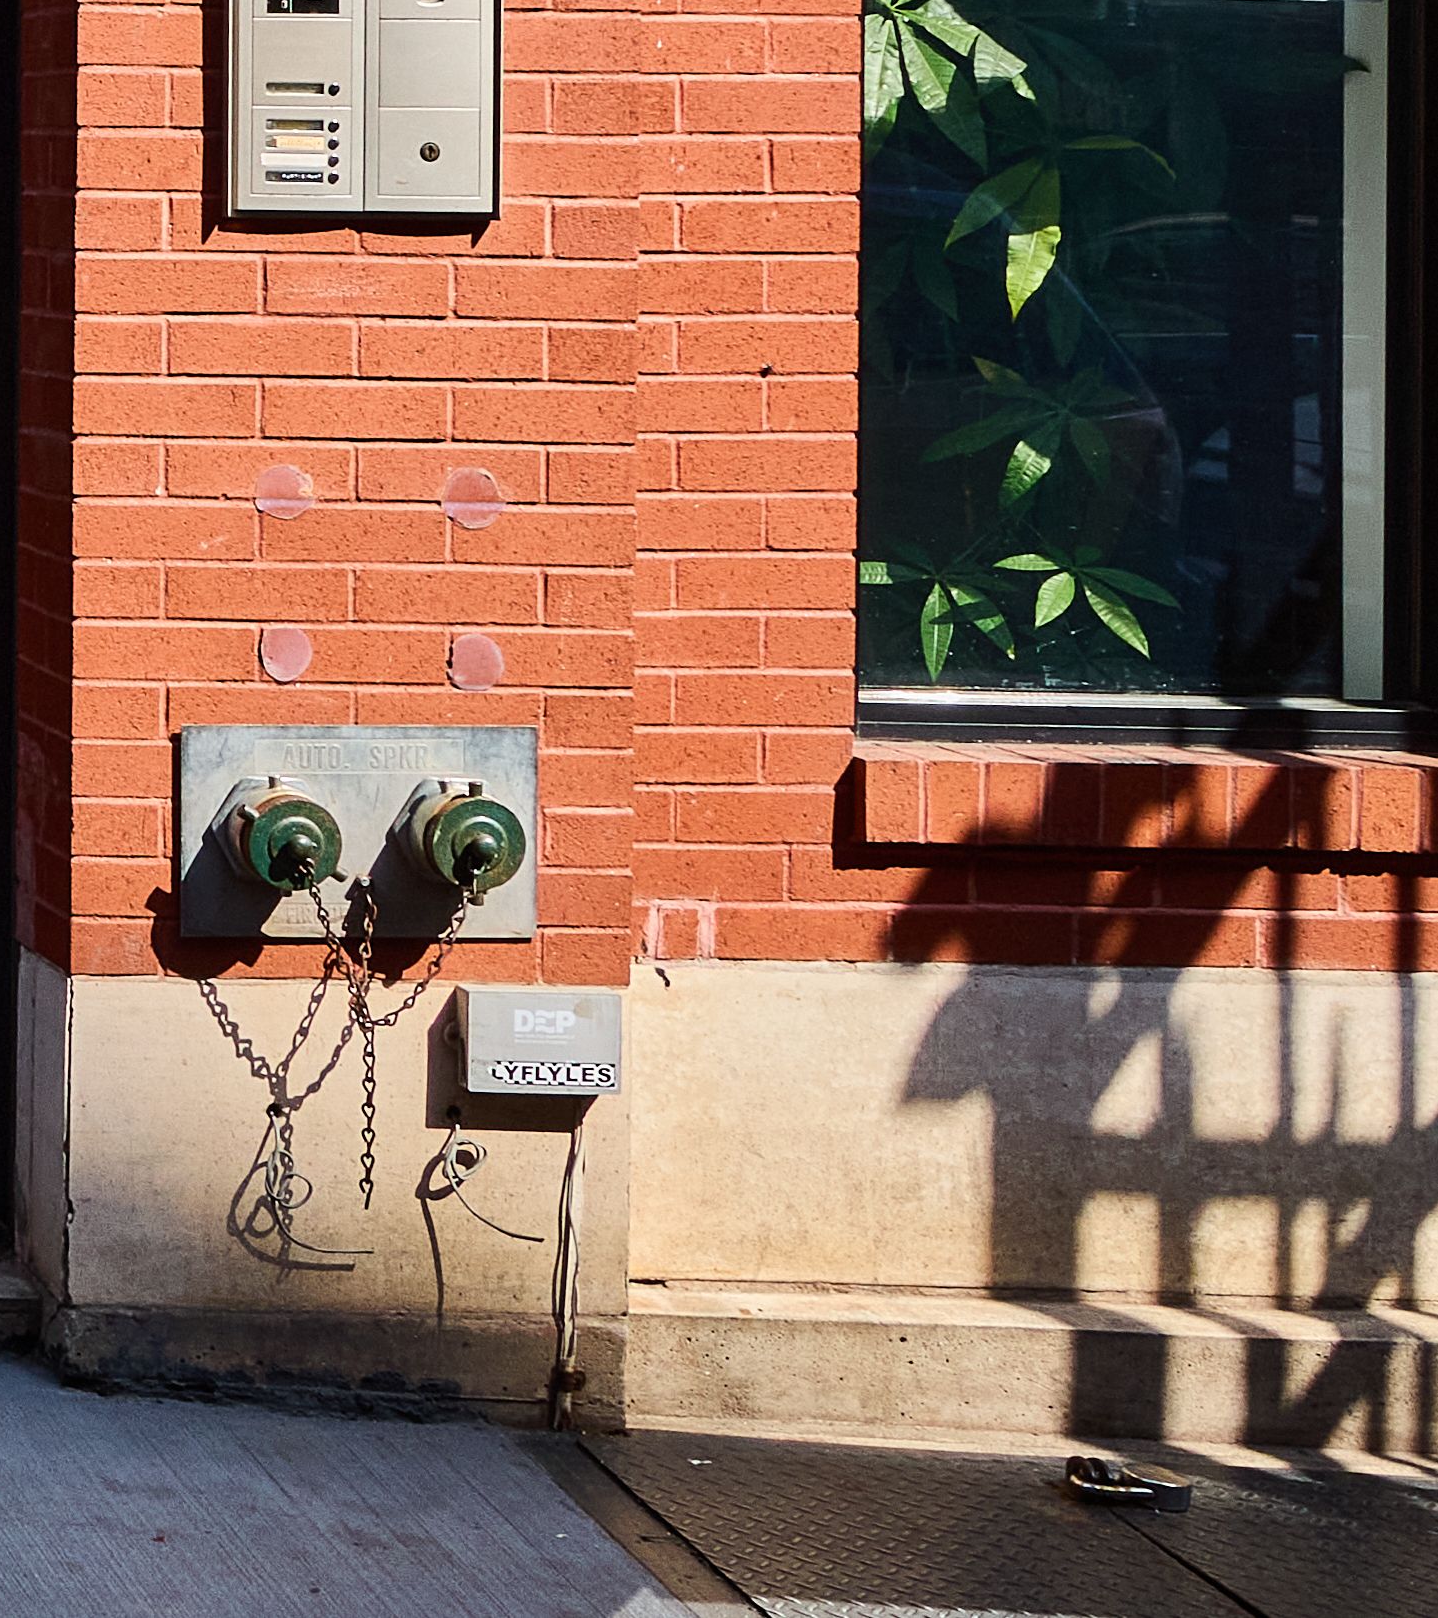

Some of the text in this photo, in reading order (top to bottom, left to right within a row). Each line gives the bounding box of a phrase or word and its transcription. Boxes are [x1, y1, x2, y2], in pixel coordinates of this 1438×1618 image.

[284, 743, 437, 770] AUTO. SPKR.
[513, 1008, 576, 1034] DEP
